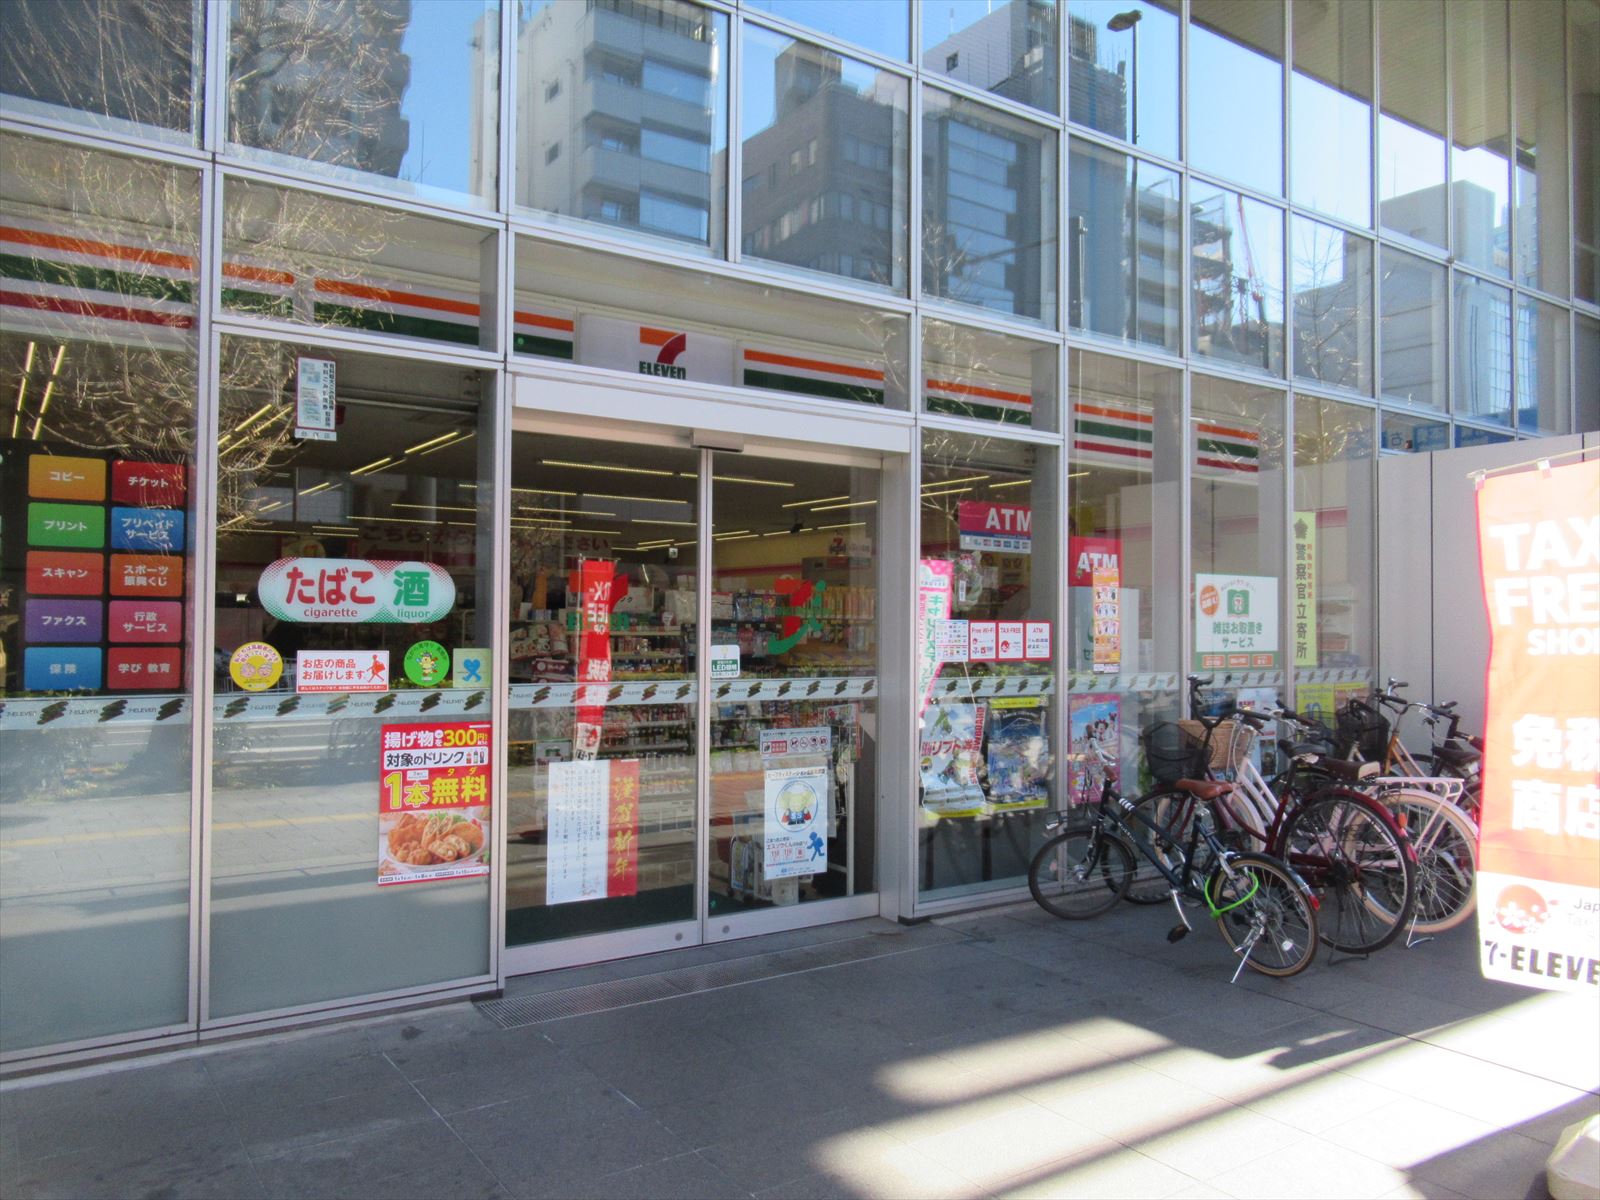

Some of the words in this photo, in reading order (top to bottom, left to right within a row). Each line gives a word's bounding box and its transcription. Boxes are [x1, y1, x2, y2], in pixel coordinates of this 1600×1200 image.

[49, 471, 85, 482] コピー
[128, 476, 169, 488] チケット
[43, 519, 88, 531] プリント
[985, 507, 1032, 532] ATM
[125, 529, 169, 540] サービス
[1077, 552, 1118, 573] ATM
[42, 567, 88, 578] スキャン
[124, 564, 169, 575] スポーツ
[286, 566, 376, 606] たばこ
[392, 570, 431, 607] 酒
[1295, 543, 1307, 659] 警察官立寄所
[134, 611, 157, 621] 行政
[303, 607, 358, 619] cigarette
[397, 608, 431, 620] liquor
[41, 615, 87, 626] ファクス
[122, 623, 168, 633] サービス
[1222, 637, 1254, 648] サービス
[302, 658, 357, 669] お店の商品
[302, 670, 366, 681] お届けします
[386, 751, 464, 767] 対象のドリンク
